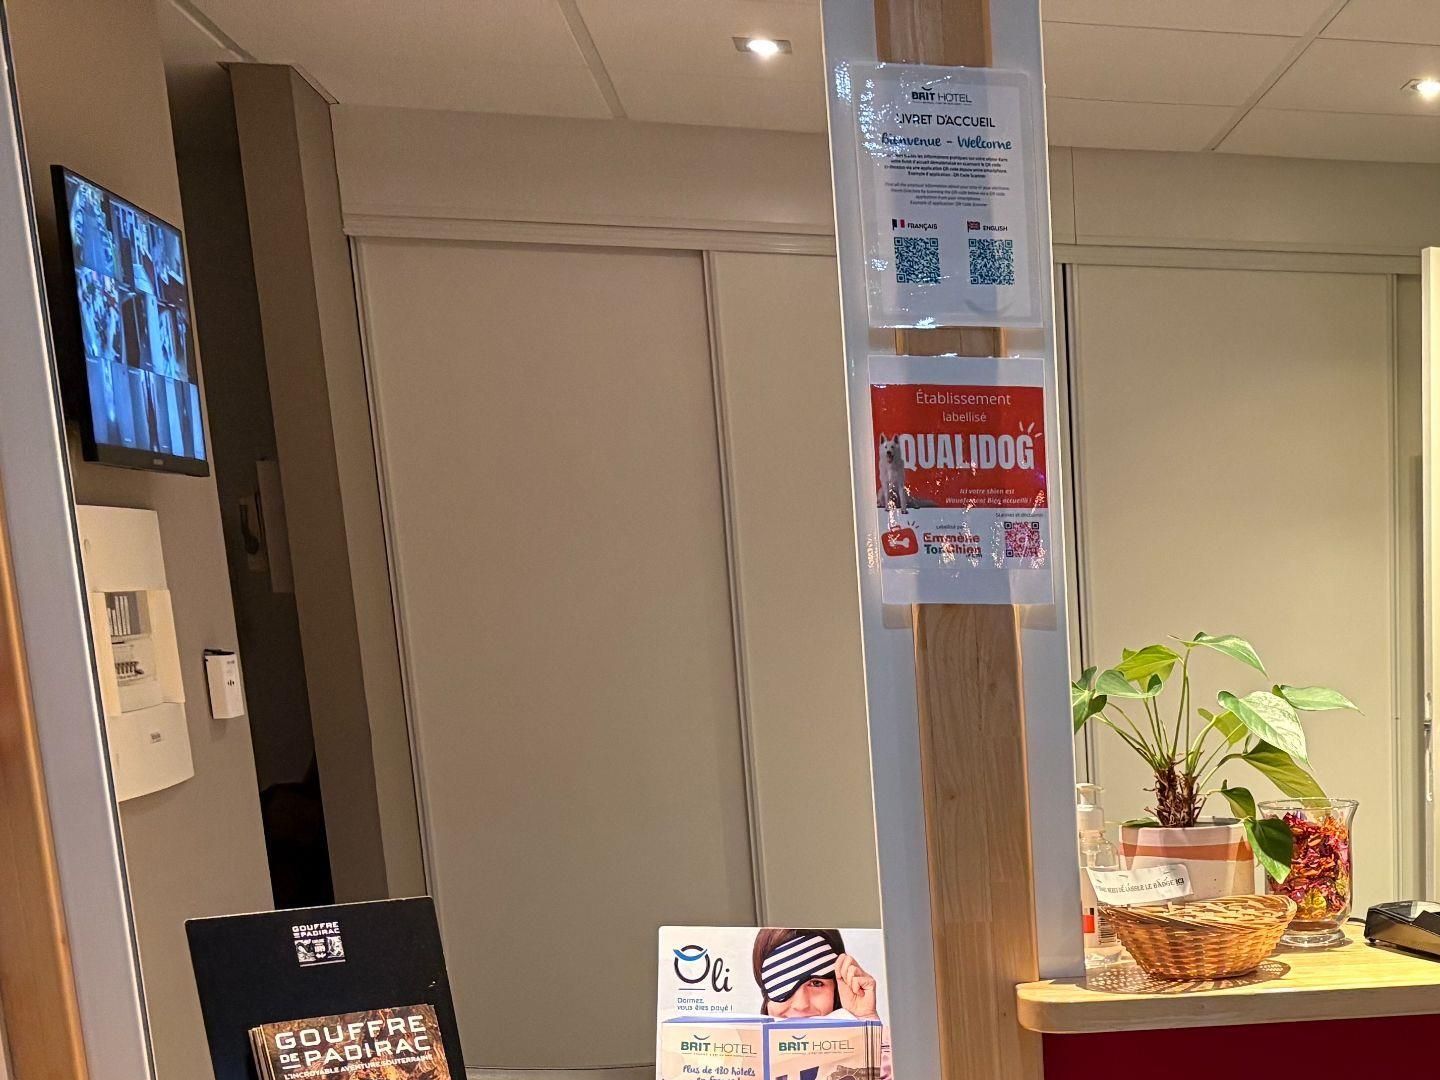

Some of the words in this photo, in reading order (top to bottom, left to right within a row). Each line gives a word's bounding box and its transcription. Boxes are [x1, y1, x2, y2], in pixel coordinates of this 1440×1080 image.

[938, 93, 973, 103] HOTEL
[936, 114, 996, 128] D'ACCUEIL
[957, 135, 1012, 150] Welcome
[915, 388, 1011, 406] Établissement
[942, 411, 987, 423] labellisé
[899, 433, 1035, 472] QUALIDOG
[292, 921, 339, 933] GOUFFRE
[300, 927, 341, 938] PADIRAC
[710, 1003, 728, 1013] payé
[274, 1015, 427, 1050] GOUFFRE
[279, 1052, 299, 1064] DE
[303, 1035, 431, 1067] PADIRAC
[680, 1041, 711, 1052] BRIT
[713, 1042, 758, 1055] HOTEL
[778, 1041, 809, 1052] BRIT
[812, 1039, 855, 1051] HOTEL
[284, 1066, 340, 1080] L'INCROYABLE
[340, 1061, 380, 1073] AVENTURE
[683, 1065, 700, 1075] Plus
[702, 1066, 713, 1075] de
[731, 1066, 756, 1077] hôtels
